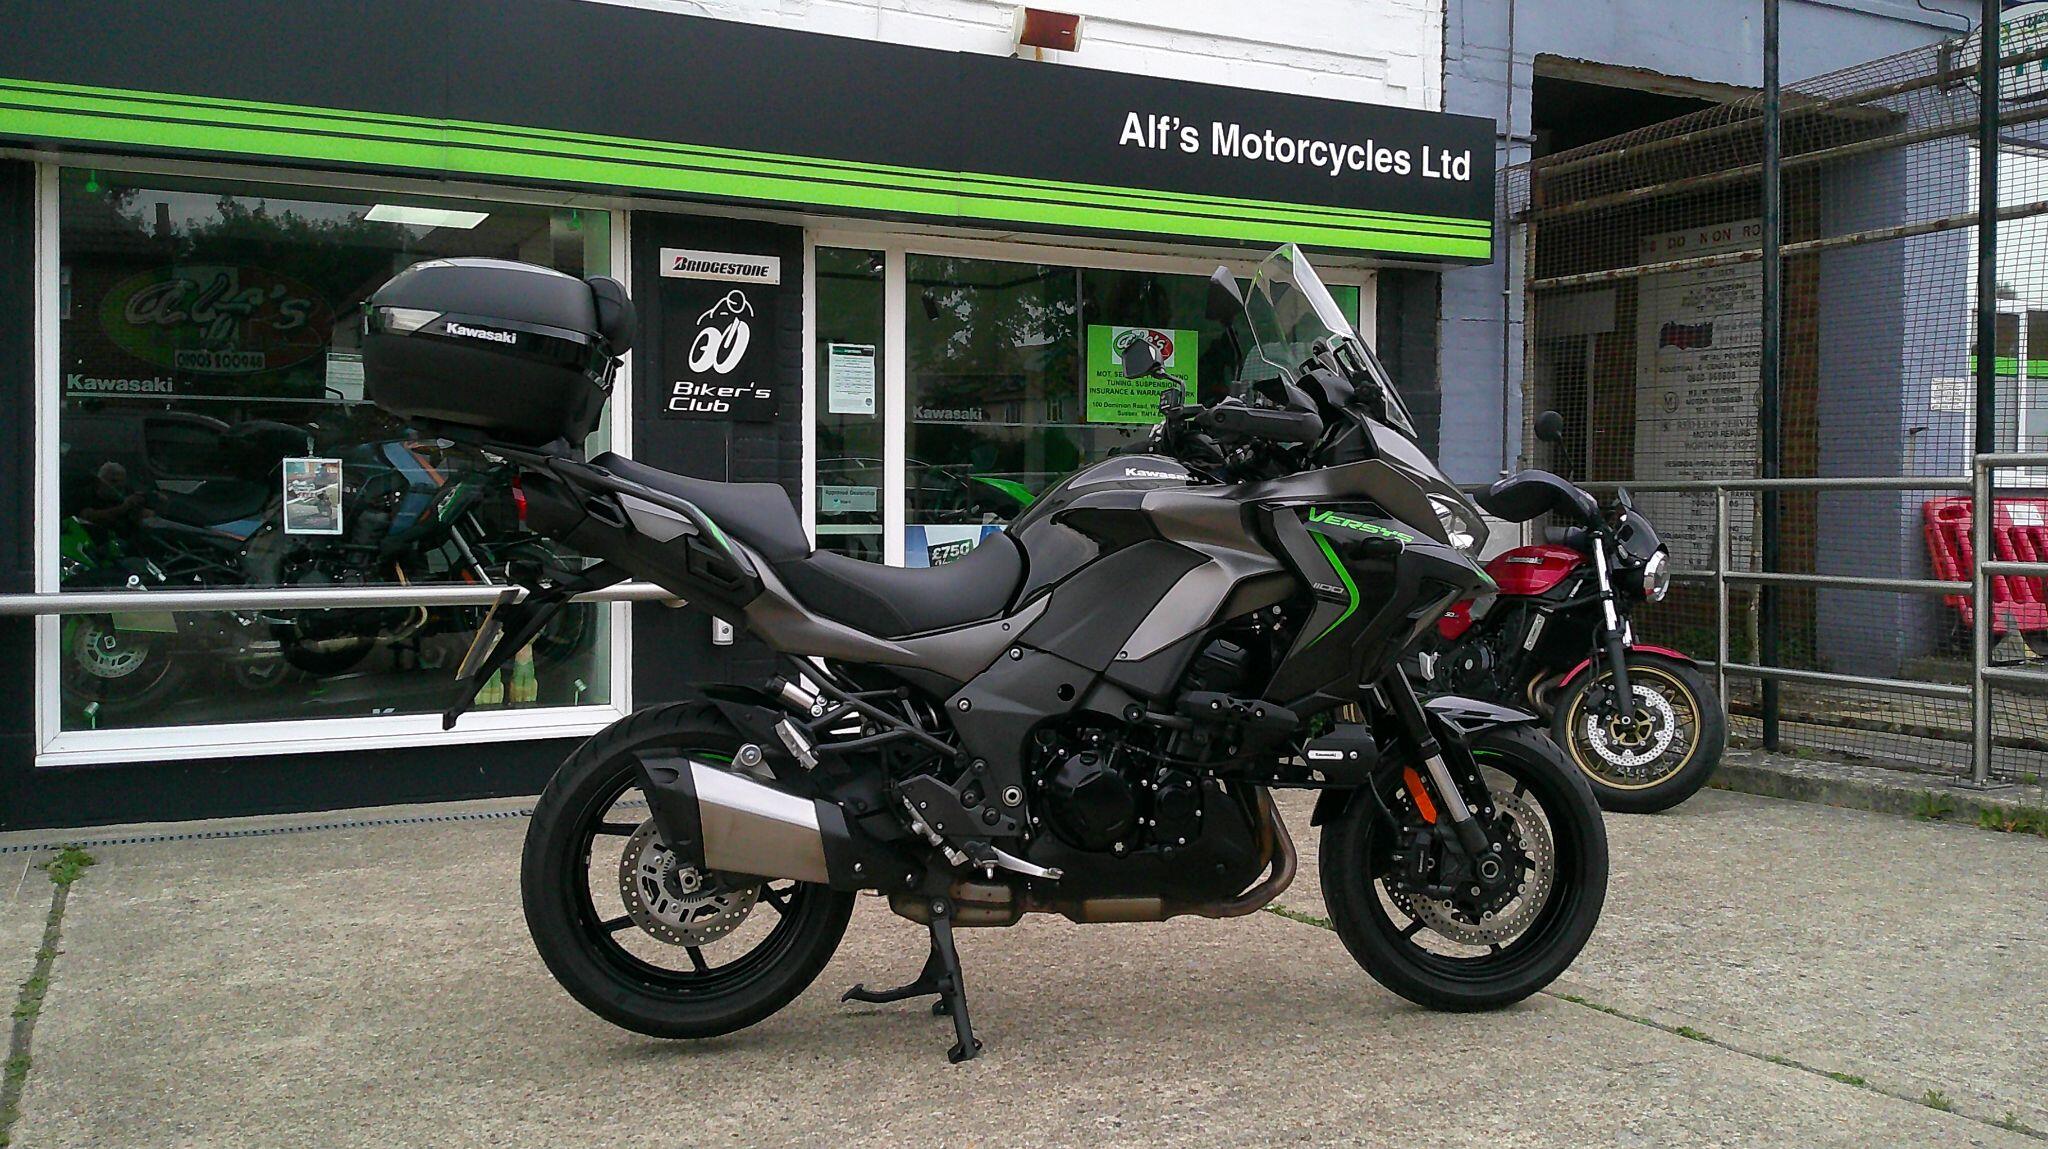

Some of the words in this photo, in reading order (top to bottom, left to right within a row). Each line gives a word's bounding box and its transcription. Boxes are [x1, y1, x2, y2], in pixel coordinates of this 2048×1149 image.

[1119, 111, 1200, 153] Alf's
[1211, 121, 1411, 176] Motorcycles
[1421, 145, 1471, 181] Ltd
[673, 256, 769, 277] BRIDGESTONE
[446, 322, 517, 345] Kawasaki
[67, 373, 174, 392] Kawasaki
[672, 380, 771, 399] Biker's
[1089, 388, 1128, 396] INSURANCE
[668, 397, 730, 412] Club
[913, 404, 983, 421] Kawasaki
[1103, 401, 1131, 409] Dominion
[1125, 468, 1199, 482] Kawasaki
[1309, 507, 1415, 543] VERSYS
[932, 543, 970, 561] £750
